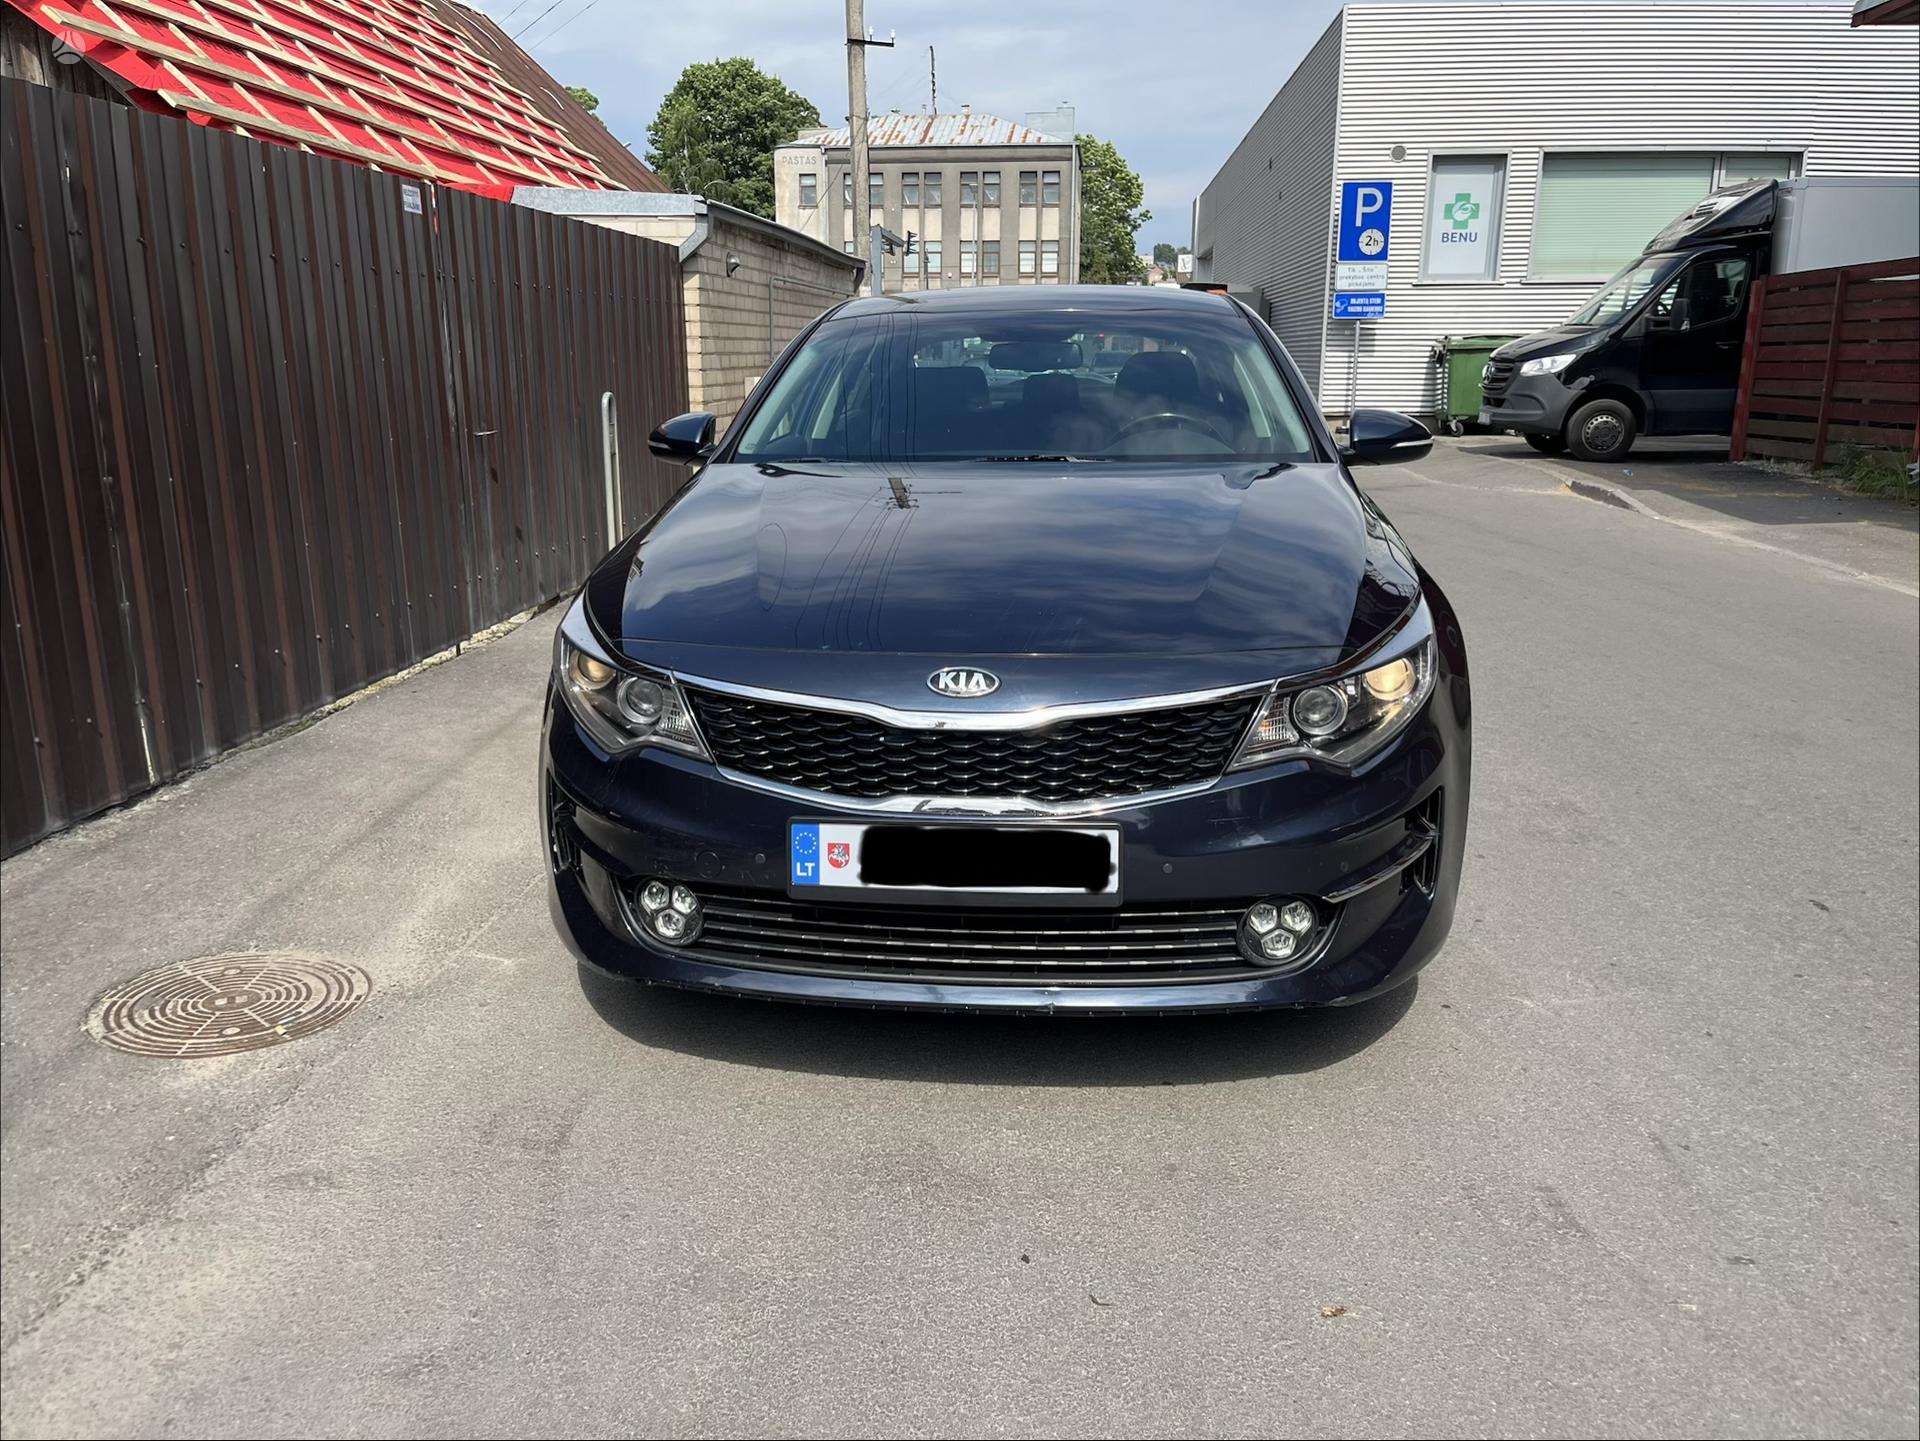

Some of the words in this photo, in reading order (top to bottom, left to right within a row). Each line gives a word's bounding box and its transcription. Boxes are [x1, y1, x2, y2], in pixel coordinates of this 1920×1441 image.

[1355, 187, 1383, 227] P
[1365, 235, 1379, 247] 2h
[1441, 232, 1478, 243] BENU
[938, 671, 988, 691] KIA
[796, 863, 815, 877] LT
